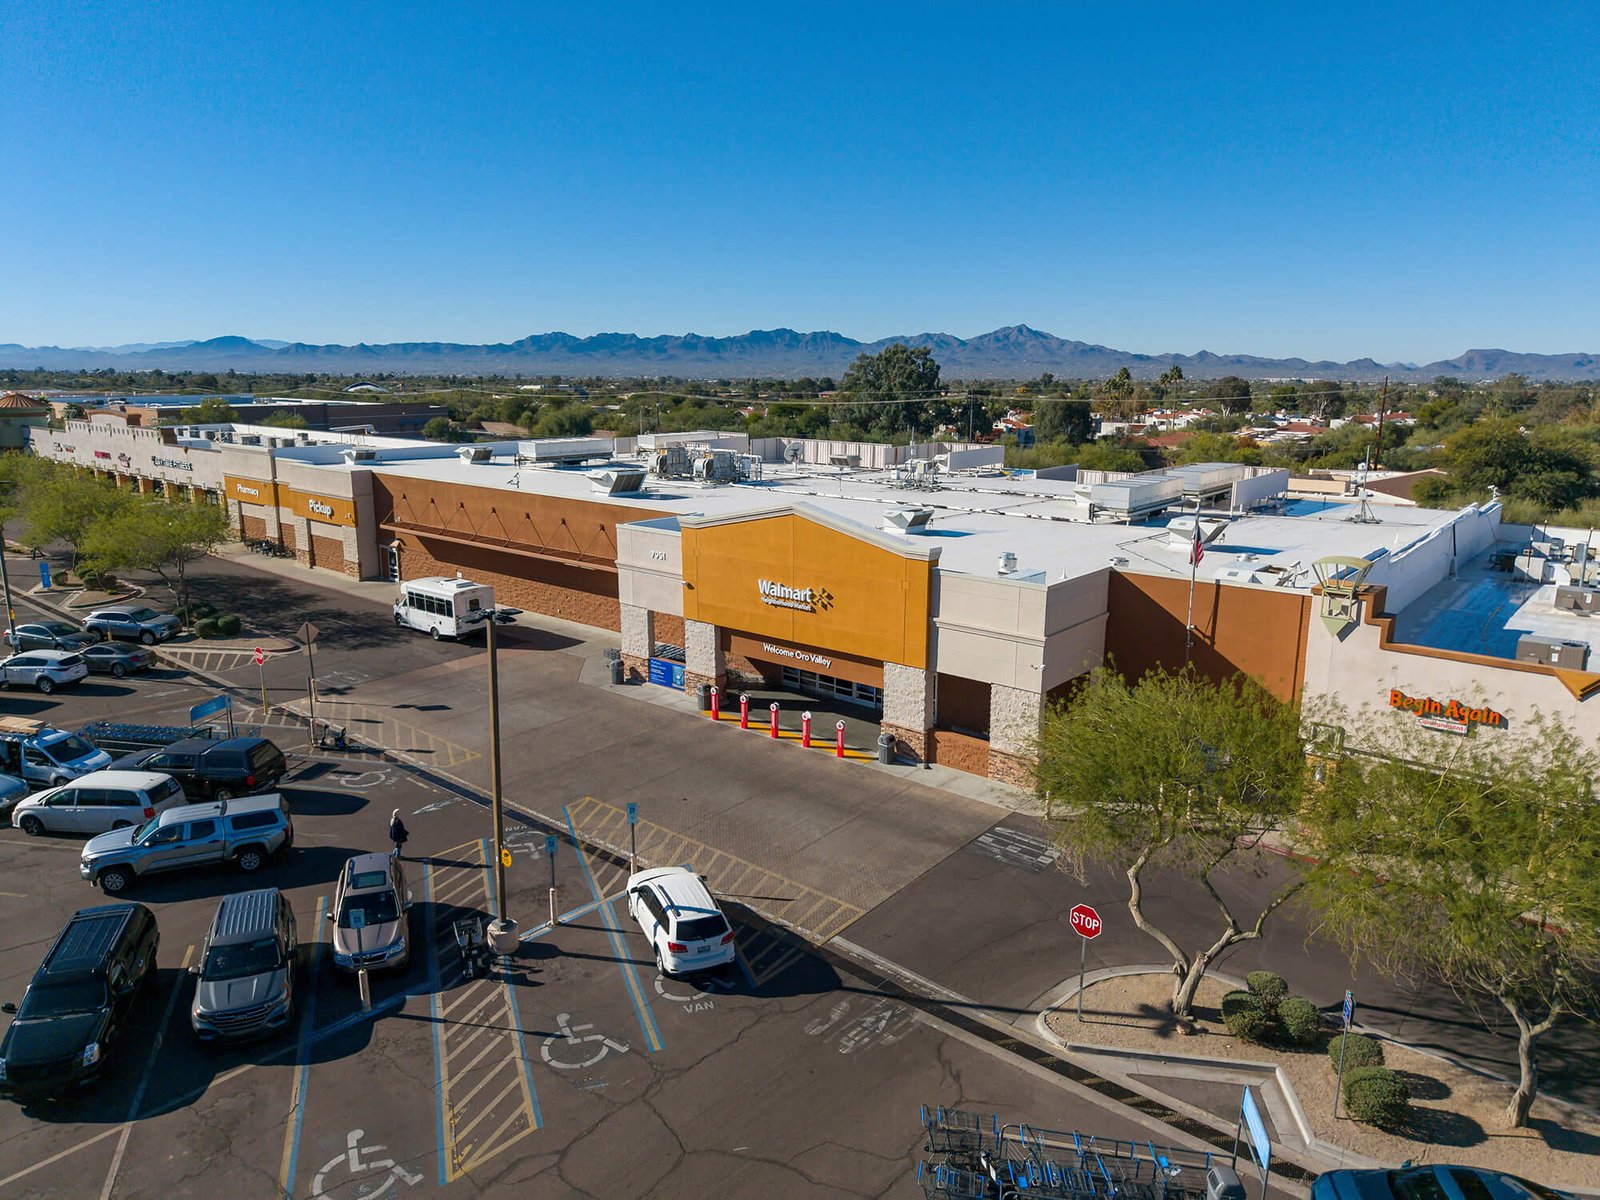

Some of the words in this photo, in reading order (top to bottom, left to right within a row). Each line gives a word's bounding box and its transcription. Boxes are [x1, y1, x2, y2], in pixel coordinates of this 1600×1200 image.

[237, 484, 259, 498] Pharmacy
[308, 499, 332, 519] Pickup
[758, 579, 812, 602] Walmart
[763, 643, 794, 658] Welcome
[795, 650, 810, 661] Oro
[810, 654, 831, 668] Valley
[1389, 690, 1441, 716] Begin
[1444, 699, 1500, 725] Again
[1072, 911, 1100, 931] STOP
[683, 1001, 715, 1013] VAN
